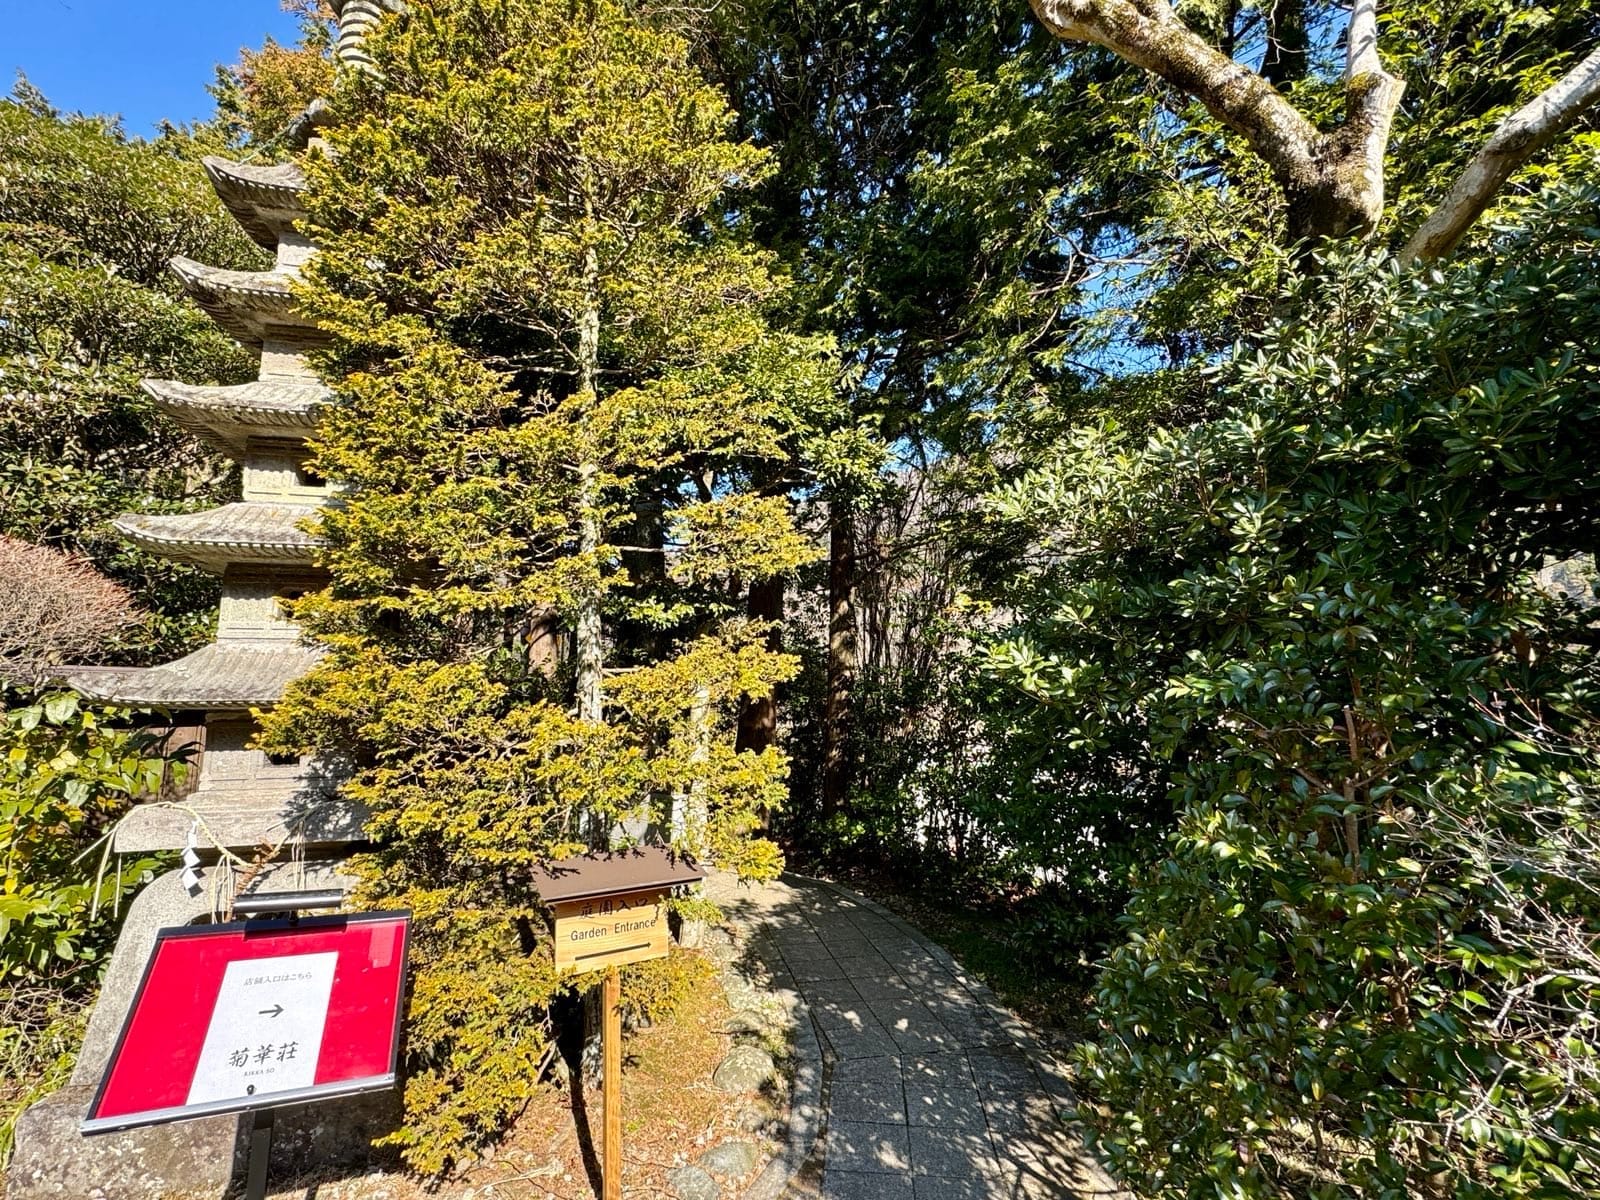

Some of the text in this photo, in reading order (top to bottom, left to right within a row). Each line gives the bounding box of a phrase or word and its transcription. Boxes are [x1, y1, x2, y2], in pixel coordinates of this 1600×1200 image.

[570, 919, 656, 941] Garden Entrance
[243, 971, 313, 986] 店舗入口はこちら
[229, 1041, 299, 1068] 菊華荘
